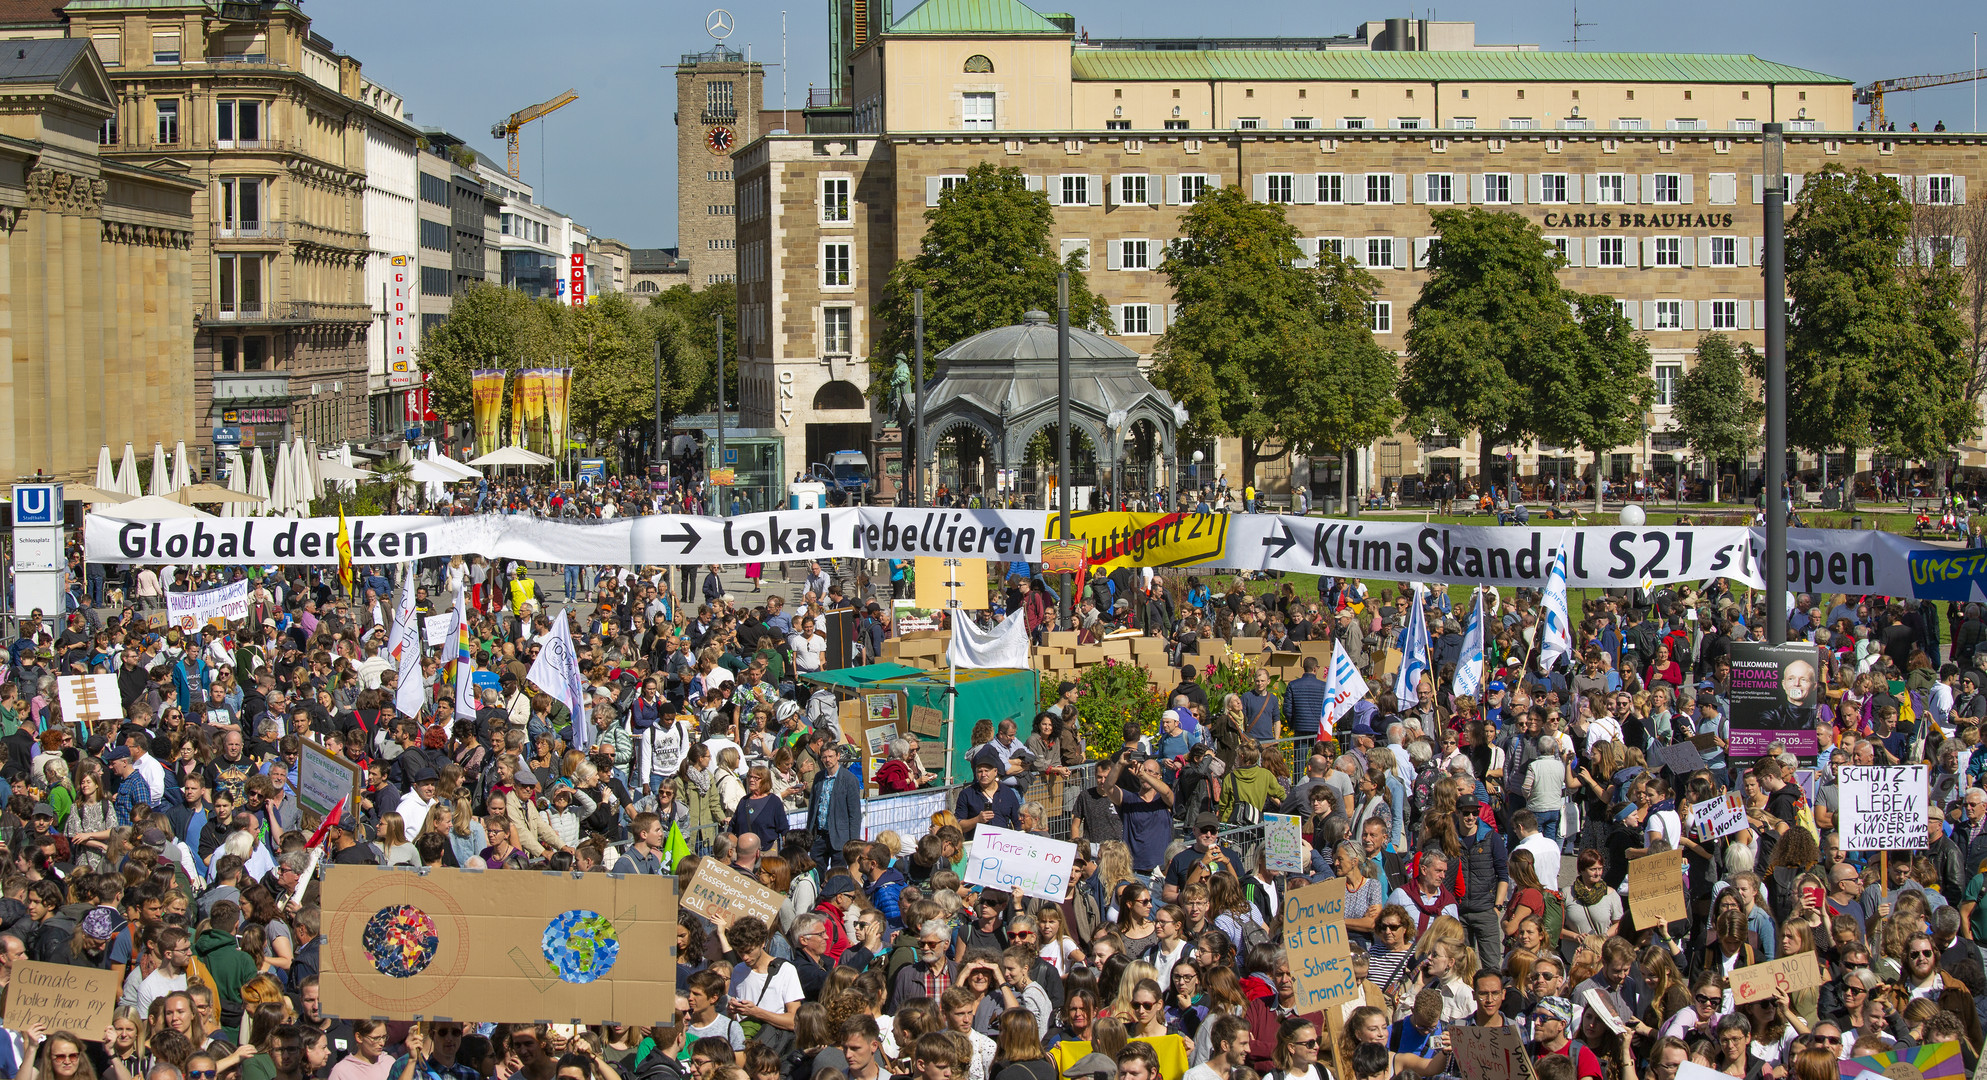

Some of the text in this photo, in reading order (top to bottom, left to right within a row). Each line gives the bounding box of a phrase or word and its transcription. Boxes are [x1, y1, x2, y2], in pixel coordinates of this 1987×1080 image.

[1544, 213, 1733, 228] CARLS BRAUHAUS
[395, 273, 404, 355] GLORIA
[779, 370, 794, 427] ONLY
[22, 490, 45, 514] U
[723, 512, 1036, 557] lokal rebellieren
[1187, 512, 1217, 541] 21
[118, 521, 256, 558] Global
[1311, 522, 1589, 580] KlimaSkandal
[1607, 531, 1694, 580] S21
[221, 599, 248, 617] STOPPEN
[1731, 660, 1778, 669] WILLKOMMEN
[1731, 669, 1778, 680] THOMAS
[1731, 680, 1778, 689] ZEHETMAIR
[1731, 736, 1757, 745] 22.09.
[305, 752, 349, 781] GREEN NEW DEAL
[1842, 765, 1924, 784] SCHÜTZT
[1871, 782, 1900, 793] DAS
[1695, 795, 1724, 819] Taten
[1712, 809, 1725, 821] statt
[1855, 794, 1918, 814] LEBEN
[1715, 811, 1743, 836] Worte
[1854, 822, 1906, 835] KINDER
[1863, 812, 1920, 823] UNSERER
[981, 833, 1062, 864] There is no
[1847, 835, 1929, 849] KINDESKINDER
[979, 856, 1062, 895] Planet B
[1632, 855, 1678, 875] We are the
[706, 859, 770, 899] There are no
[1646, 871, 1667, 883] ones
[1664, 883, 1682, 896] been
[748, 907, 770, 923] are
[1286, 896, 1342, 924] Oma was
[1667, 902, 1678, 913] for
[1287, 919, 1340, 950] ist ein
[1303, 956, 1347, 978] Schnee-
[1735, 958, 1799, 981] THERE IS NO
[18, 966, 99, 993] Climate is
[1308, 966, 1355, 1005] mann?
[15, 988, 107, 1015] hotter than my
[1890, 1065, 1909, 1074] THIS
